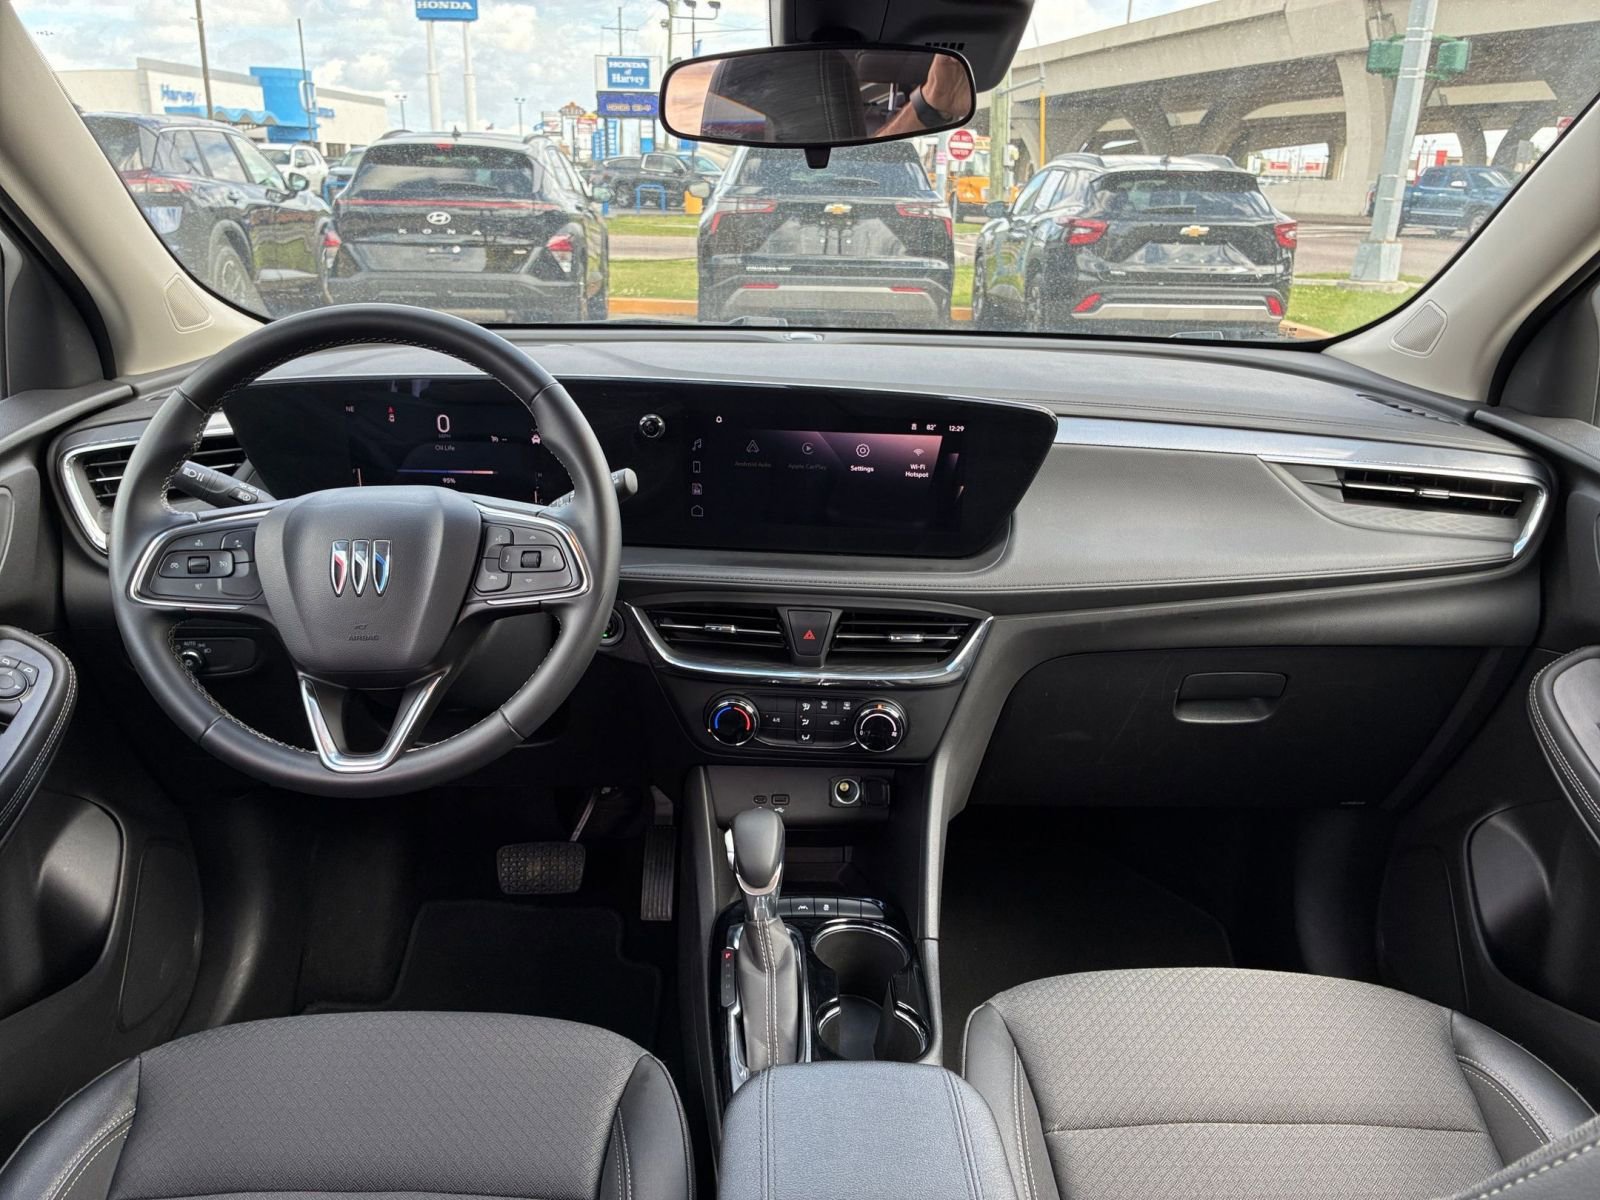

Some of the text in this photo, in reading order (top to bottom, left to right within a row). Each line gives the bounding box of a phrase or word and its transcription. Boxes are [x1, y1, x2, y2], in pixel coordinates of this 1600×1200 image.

[416, 1, 474, 10] HONDA
[611, 73, 646, 86] Harvey
[398, 228, 482, 236] KONA
[345, 405, 355, 413] NE
[436, 413, 450, 433] 0
[850, 465, 875, 473] Settings
[910, 463, 926, 471] Wi-Fi
[905, 471, 929, 479] Hotspot
